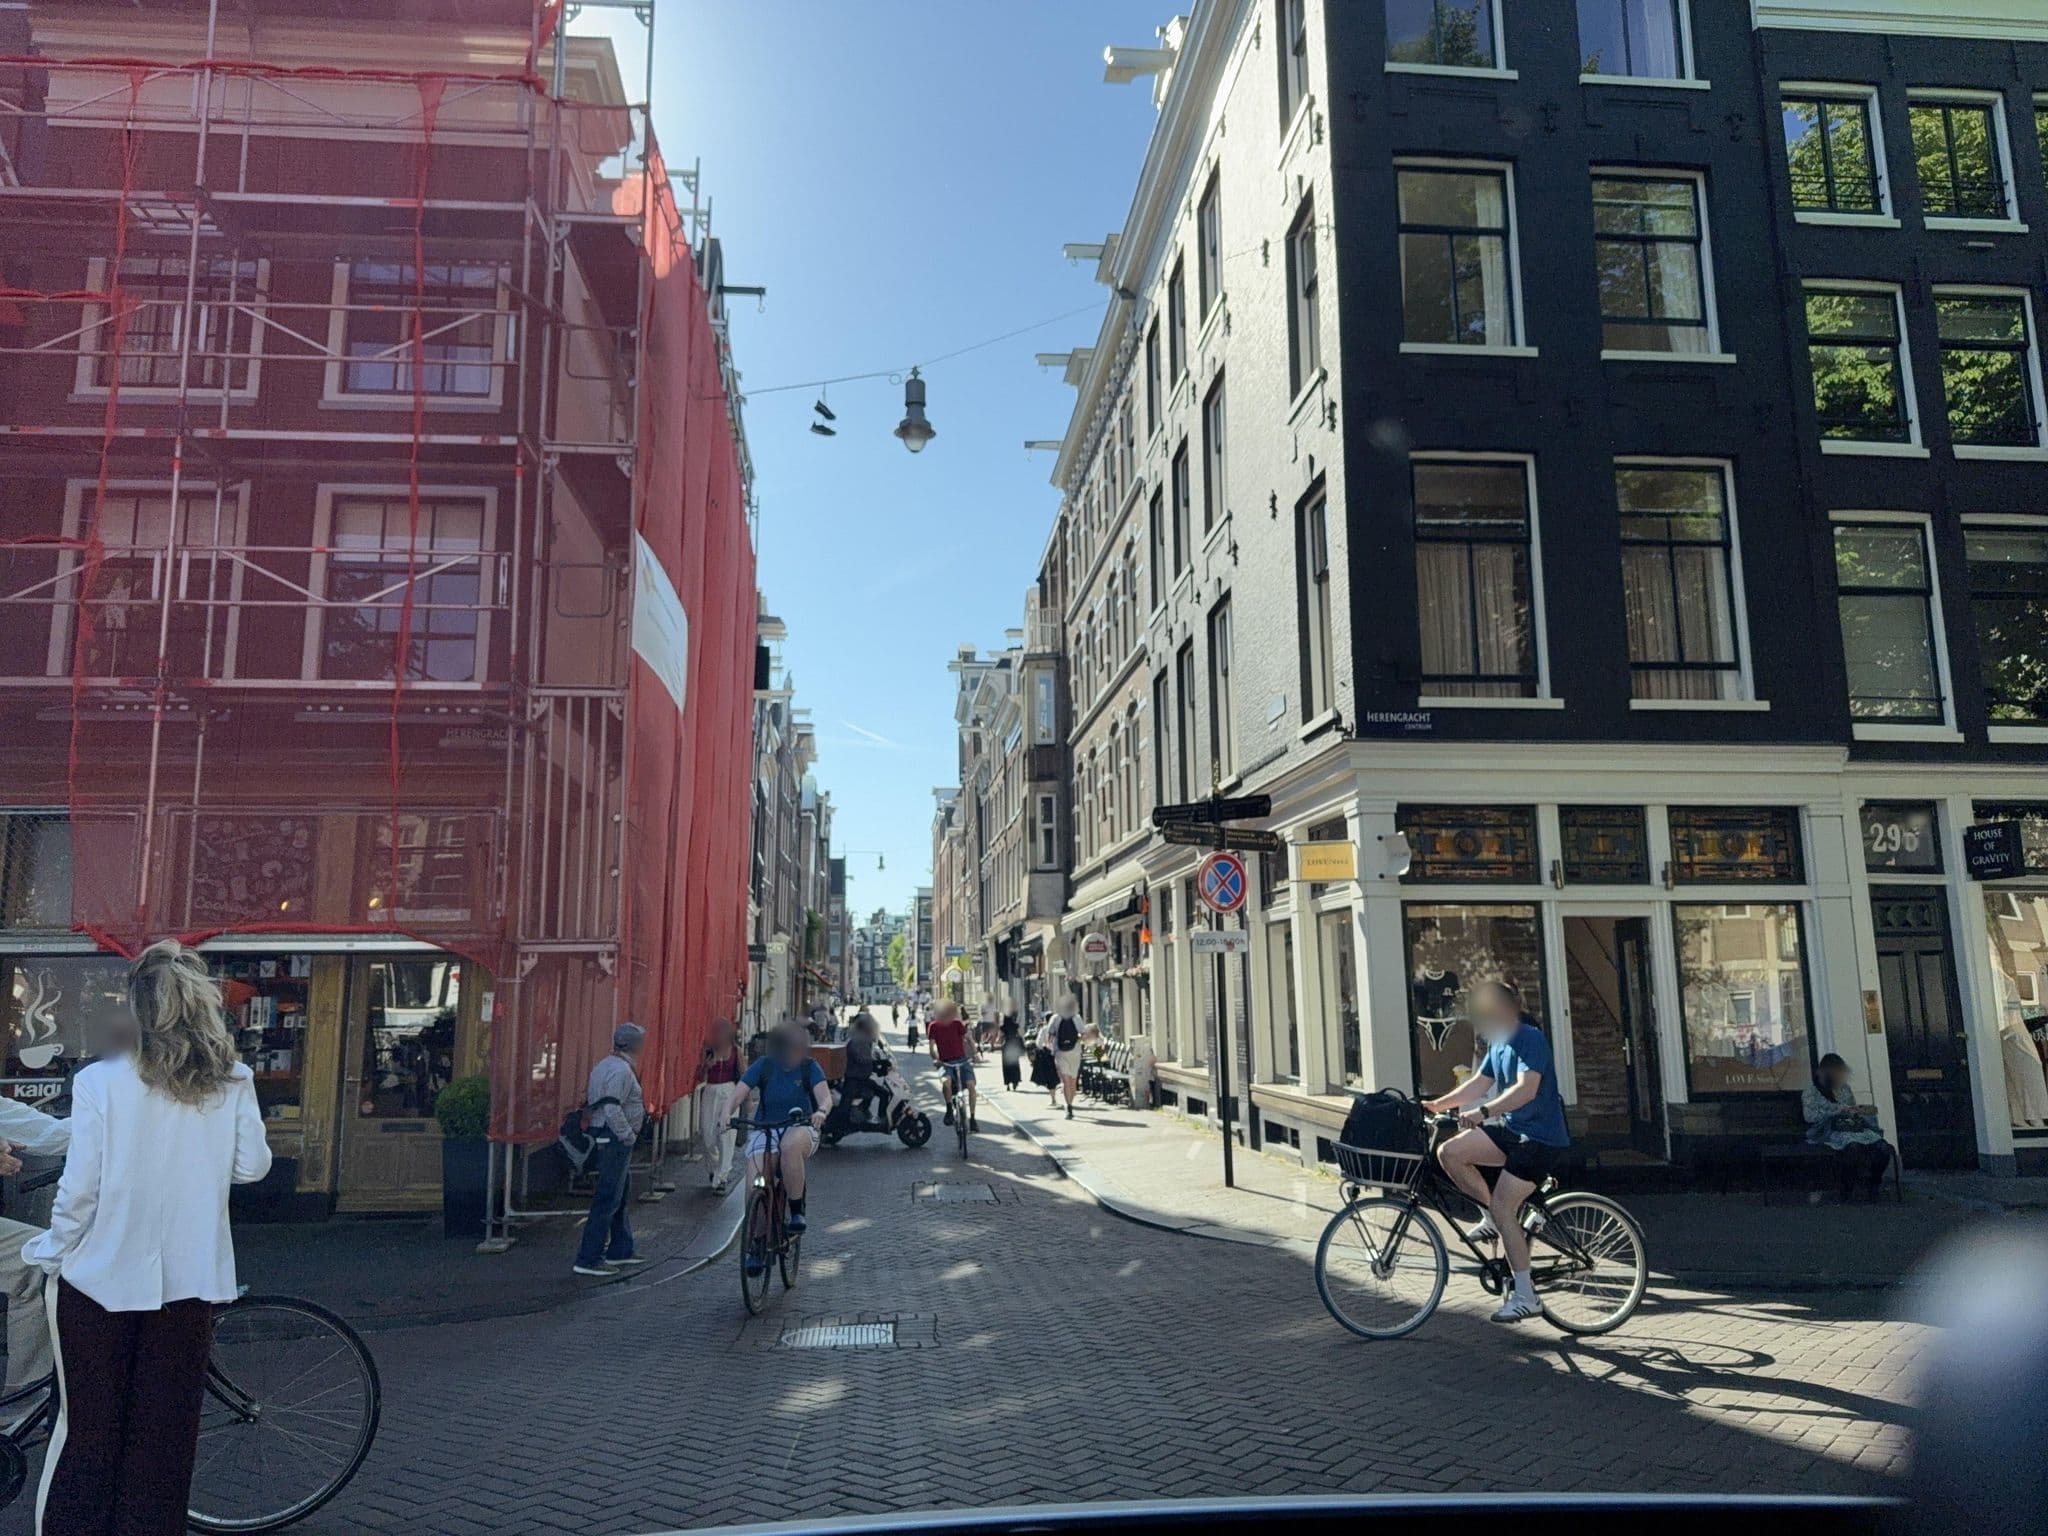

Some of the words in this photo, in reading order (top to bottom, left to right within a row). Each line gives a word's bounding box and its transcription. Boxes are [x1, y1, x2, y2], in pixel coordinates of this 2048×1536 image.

[1366, 711, 1431, 722] HERENGRACHT
[1974, 828, 2003, 840] HOUSE
[1983, 841, 1996, 851] OF
[1972, 853, 2010, 865] GRAVITY
